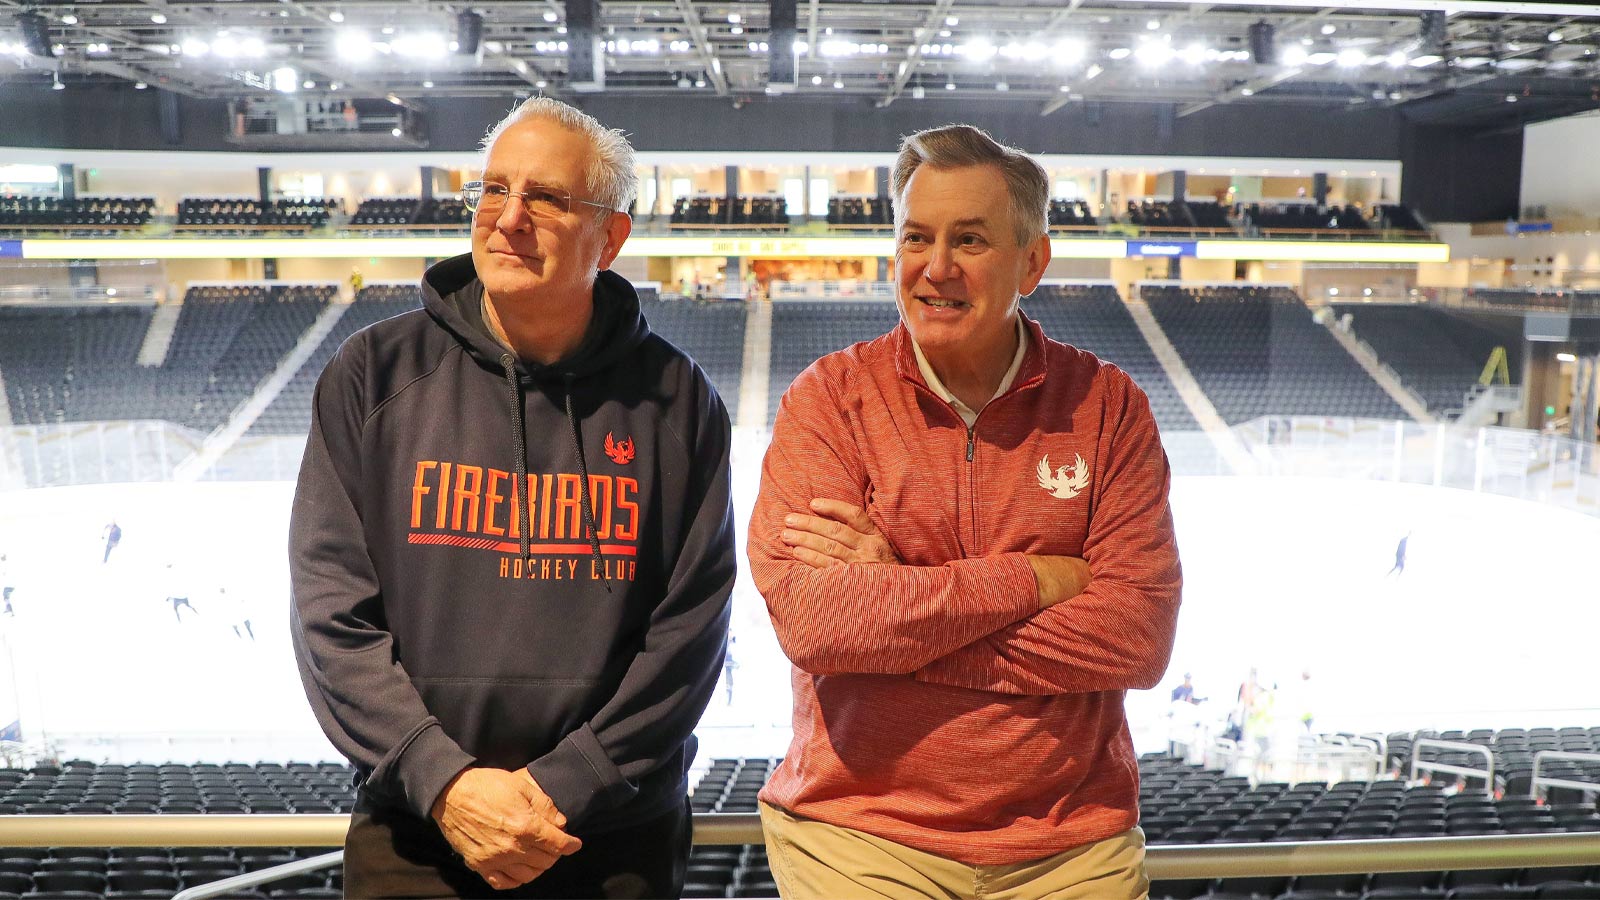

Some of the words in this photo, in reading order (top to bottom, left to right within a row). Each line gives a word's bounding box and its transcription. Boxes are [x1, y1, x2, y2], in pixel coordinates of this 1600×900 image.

[411, 461, 639, 541] FIREBIRDS
[499, 558, 578, 580] HOCKEY
[592, 560, 637, 581] CLUB
